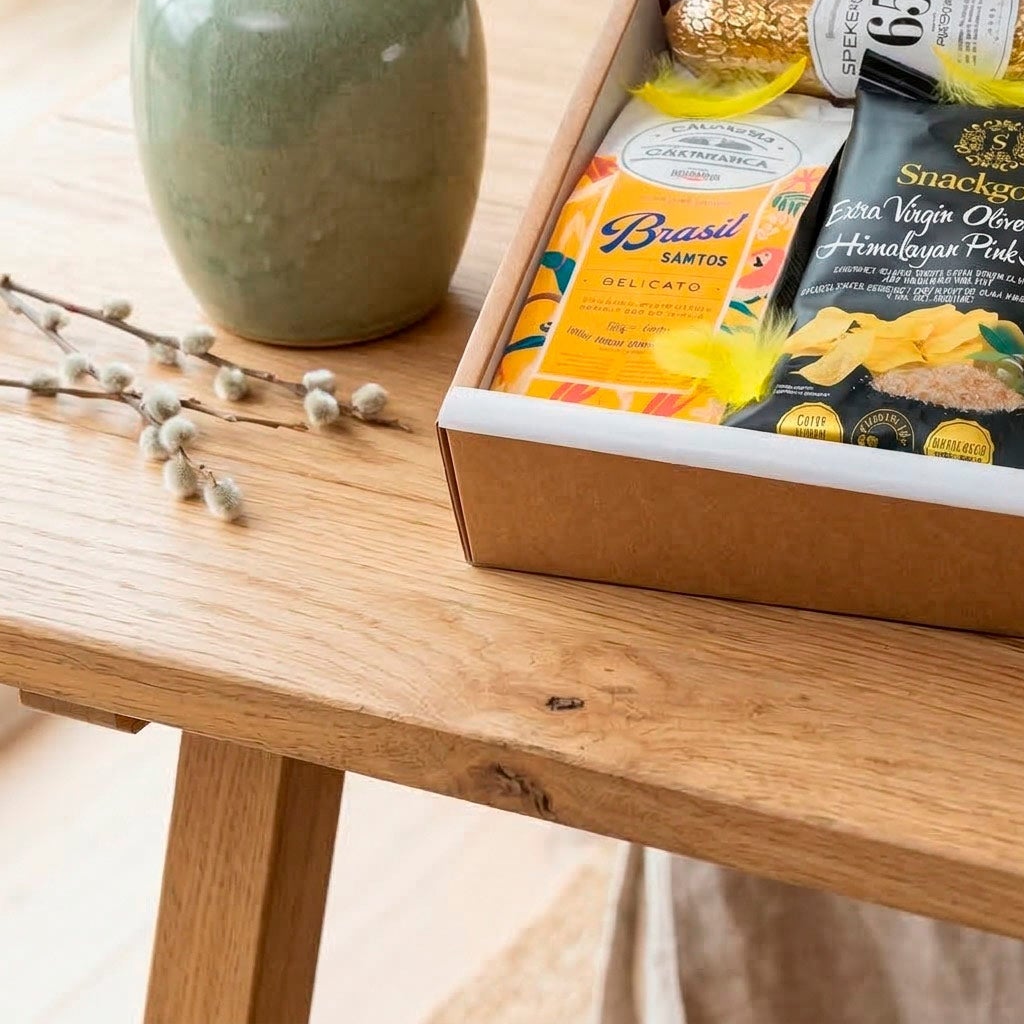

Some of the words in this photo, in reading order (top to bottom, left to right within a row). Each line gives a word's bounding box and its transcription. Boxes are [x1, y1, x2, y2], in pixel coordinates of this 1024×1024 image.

[992, 133, 1010, 151] S
[600, 212, 749, 253] Brasil
[883, 194, 954, 237] Virgin
[963, 205, 1024, 232] Olive
[661, 252, 728, 267] SAMTOS
[816, 230, 960, 269] Himalayan
[961, 233, 1019, 264] Pink
